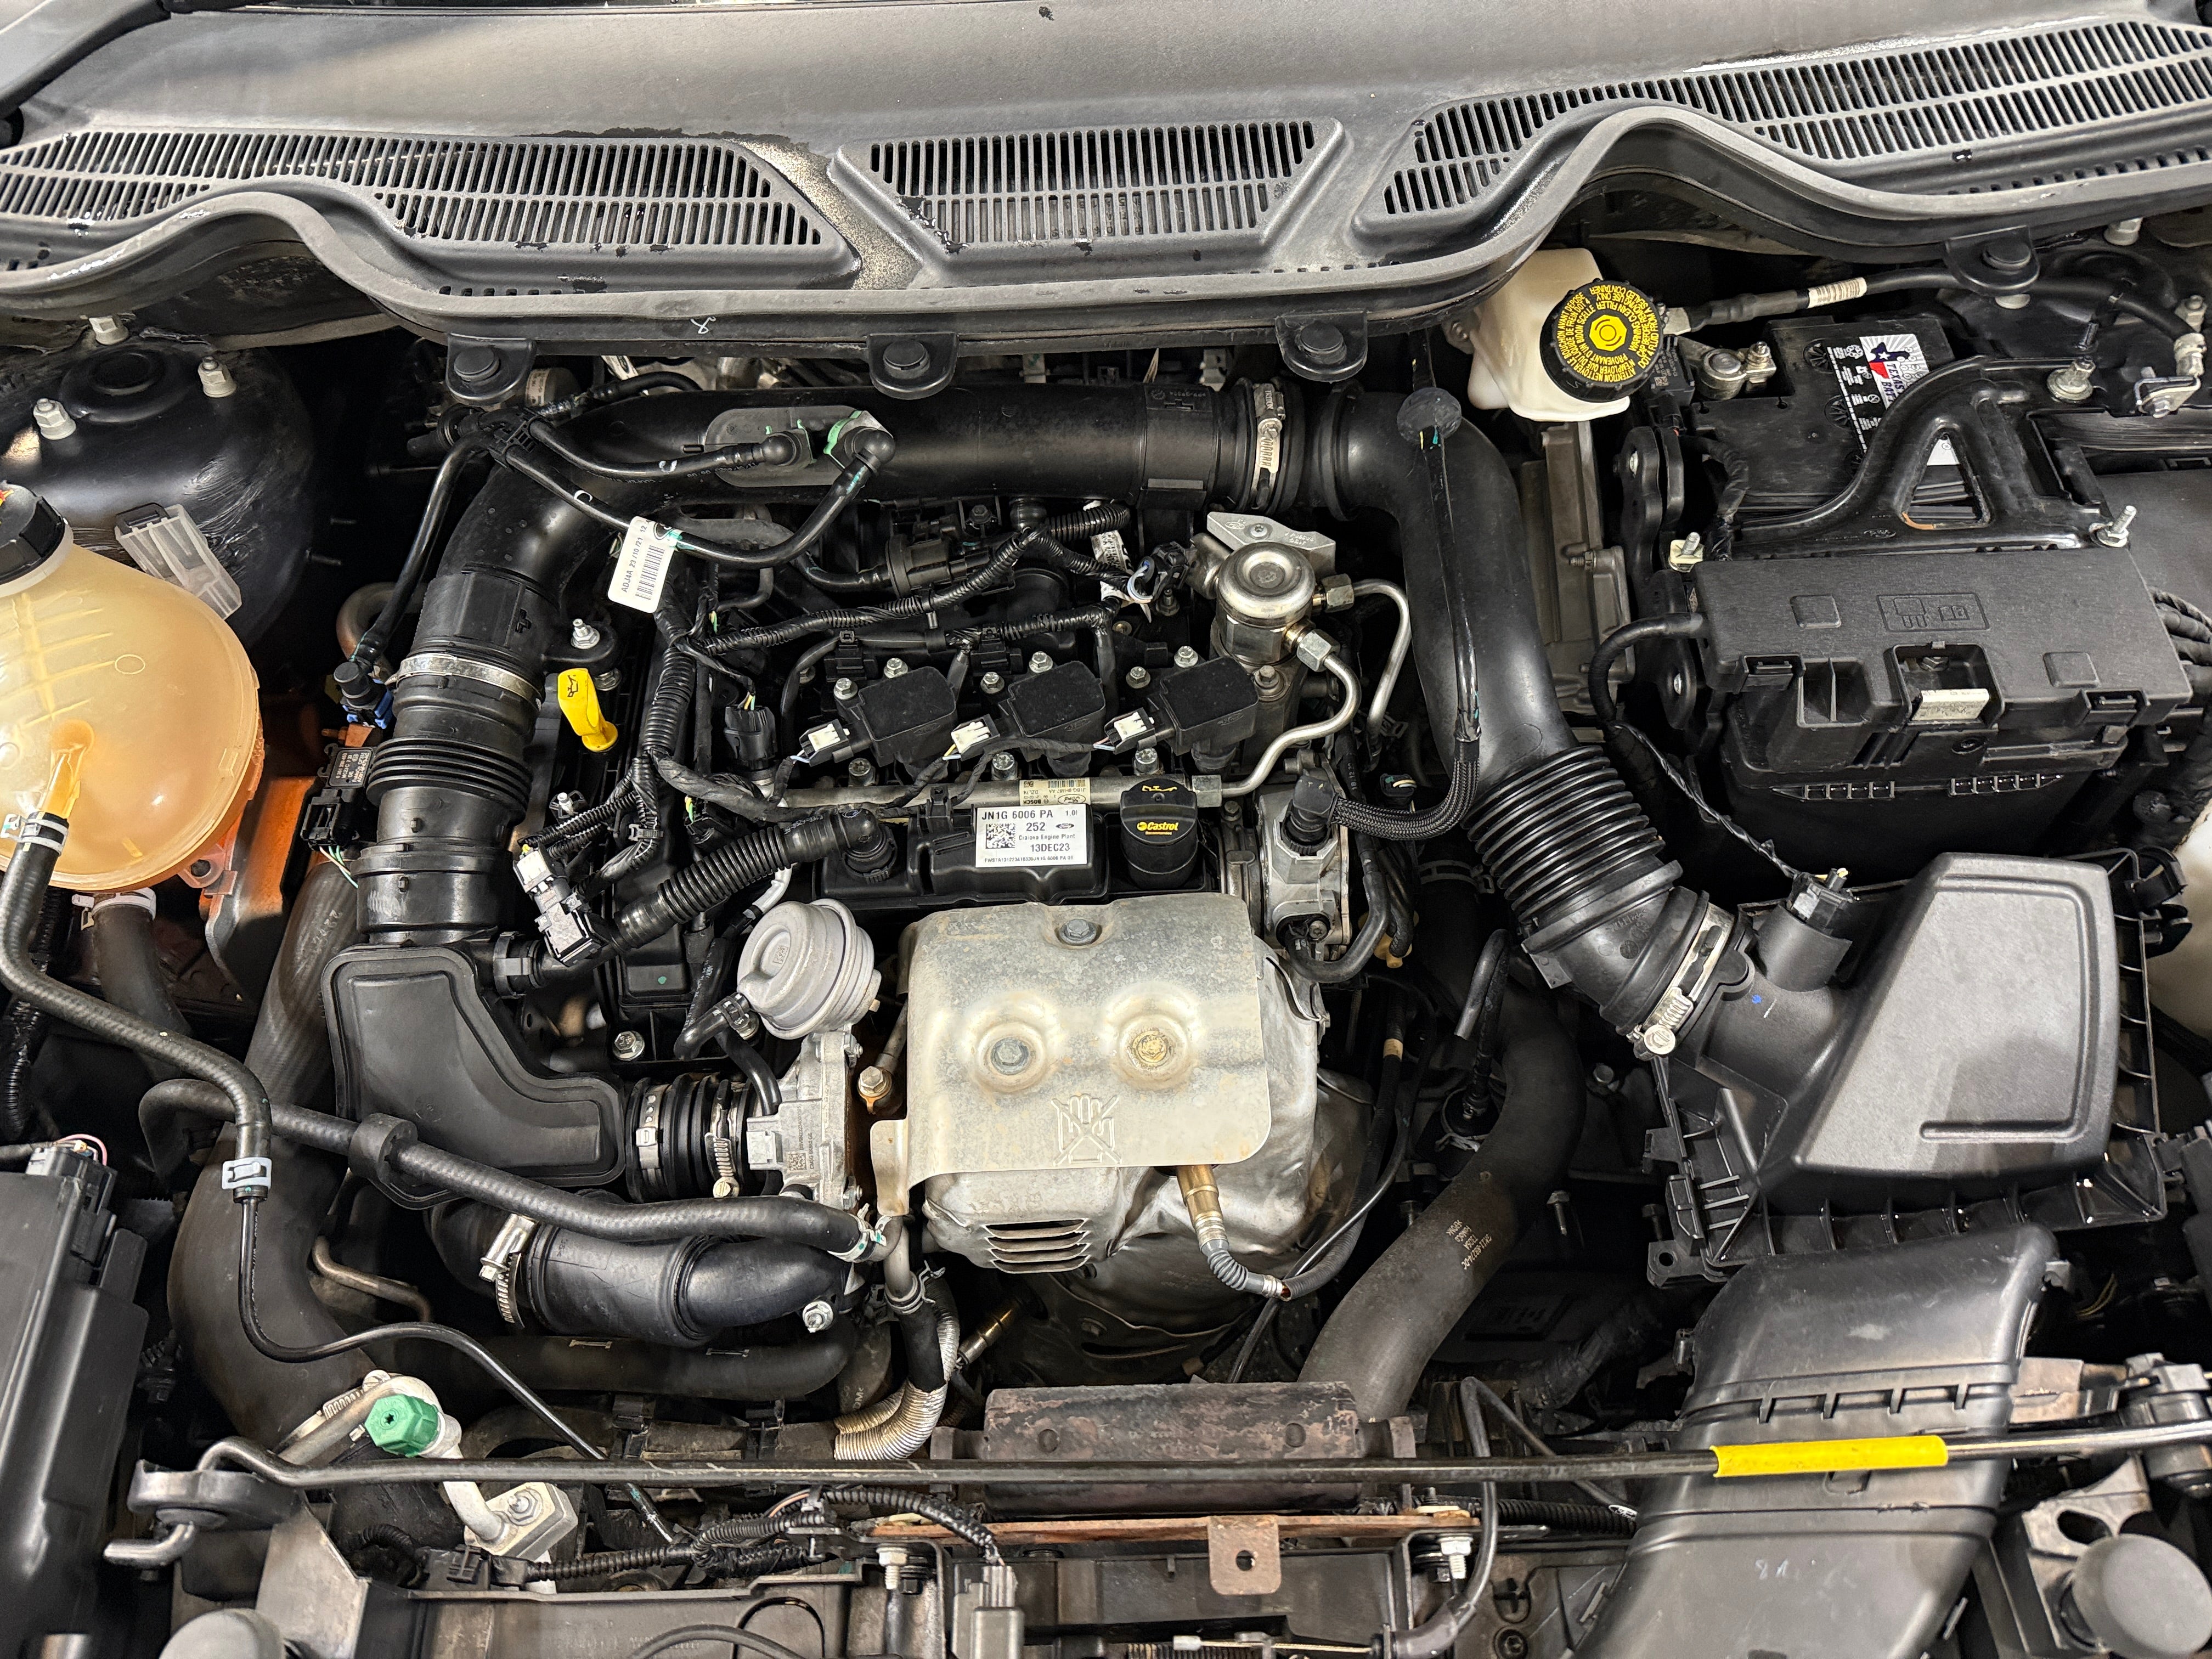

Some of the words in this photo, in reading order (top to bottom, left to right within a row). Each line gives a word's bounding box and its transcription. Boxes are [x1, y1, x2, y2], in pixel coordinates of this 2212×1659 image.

[1589, 285, 1626, 295] CONTAINER
[1596, 292, 1611, 301] ONLY
[1612, 292, 1624, 303] USE
[1565, 292, 1585, 312] DEPOSE
[1573, 300, 1586, 313] DOT
[1596, 301, 1618, 311] FILLER
[1626, 290, 1648, 310] SEALED
[1577, 304, 1596, 324] SCELLE
[1617, 304, 1637, 322] CLEAN
[1624, 297, 1647, 323] REMOVING
[1558, 311, 1570, 329] AVANT
[1566, 311, 1578, 327] FREIN
[1646, 313, 1659, 331] FROM
[1575, 325, 1585, 343] BIDON
[1628, 321, 1641, 351] WARNING
[1641, 324, 1651, 345] BEFORE
[1648, 333, 1659, 351] FLUID
[1557, 330, 1572, 359] BOUCHON
[1566, 337, 1582, 358] LIQUIDE
[1579, 342, 1593, 358] D'UN
[1637, 345, 1647, 358] CAP
[1567, 357, 1577, 366] LE
[1578, 356, 1588, 366] DU
[1585, 361, 1599, 372] QUE
[1590, 353, 1628, 365] PROVENANT
[1638, 354, 1651, 369] DOT
[1573, 363, 1603, 381] NETTOYER
[1604, 367, 1636, 382] ATTENTION
[1887, 364, 1905, 390] TEXAS
[621, 570, 633, 592] ADJ4A
[982, 811, 1008, 820] JN1G
[1012, 810, 1036, 819] 6006
[1040, 810, 1053, 818] PA
[1026, 822, 1046, 832] 252
[1147, 821, 1179, 831] Castrol
[1030, 843, 1070, 853] 13DEC23
